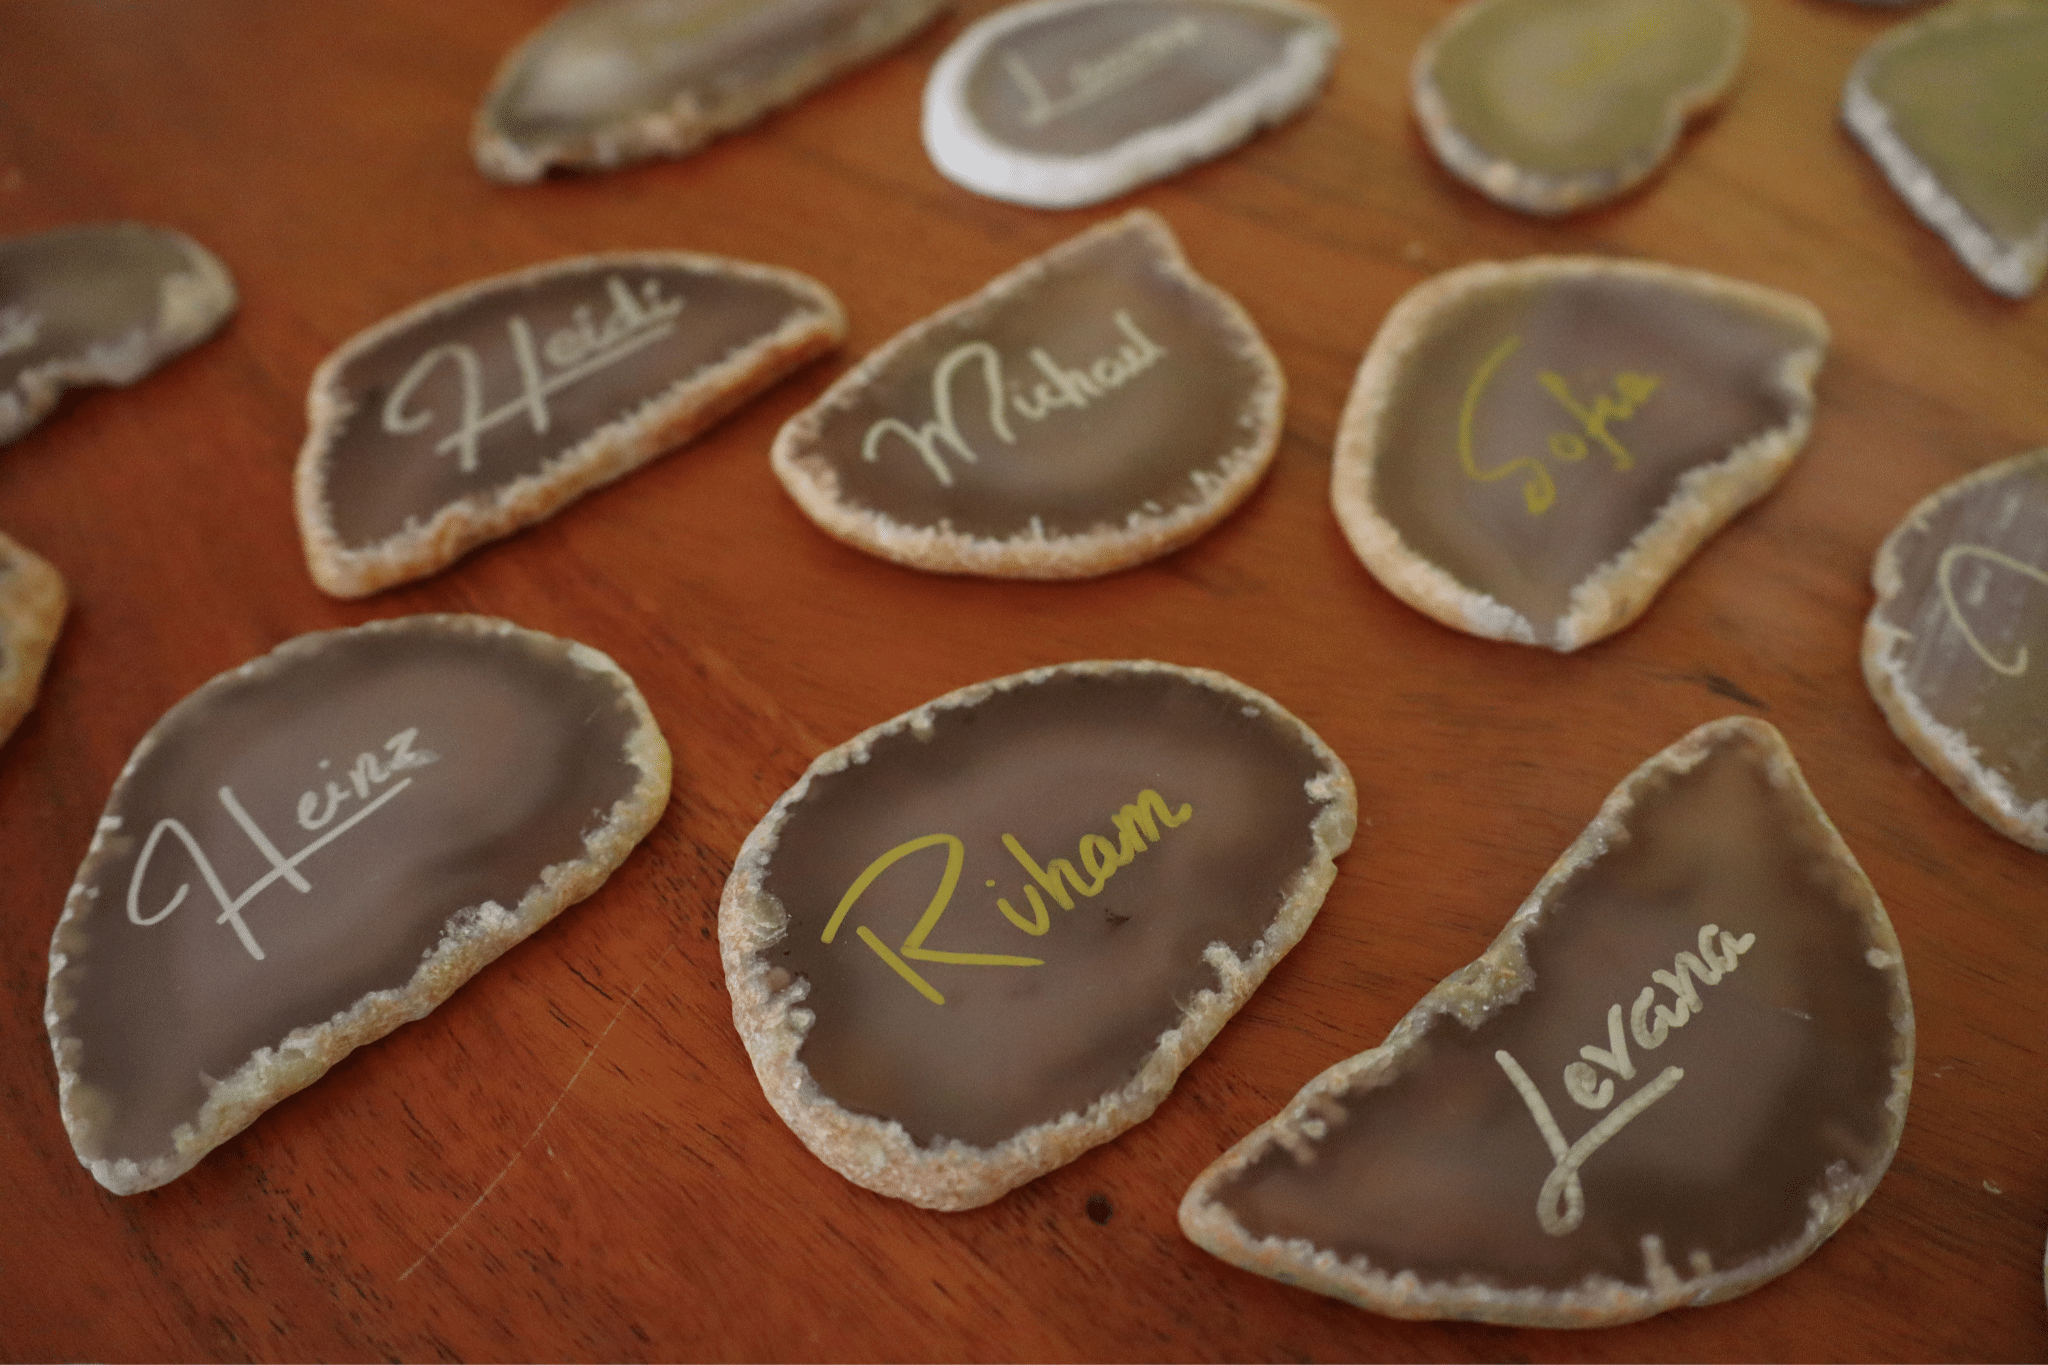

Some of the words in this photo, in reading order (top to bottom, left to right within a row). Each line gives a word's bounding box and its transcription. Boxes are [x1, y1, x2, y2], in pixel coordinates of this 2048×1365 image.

[381, 275, 684, 462] Heidi
[862, 310, 1166, 486] Michael
[127, 727, 440, 960] Heinz
[820, 789, 1193, 1005] Riham
[1495, 923, 1756, 1236] Levana
